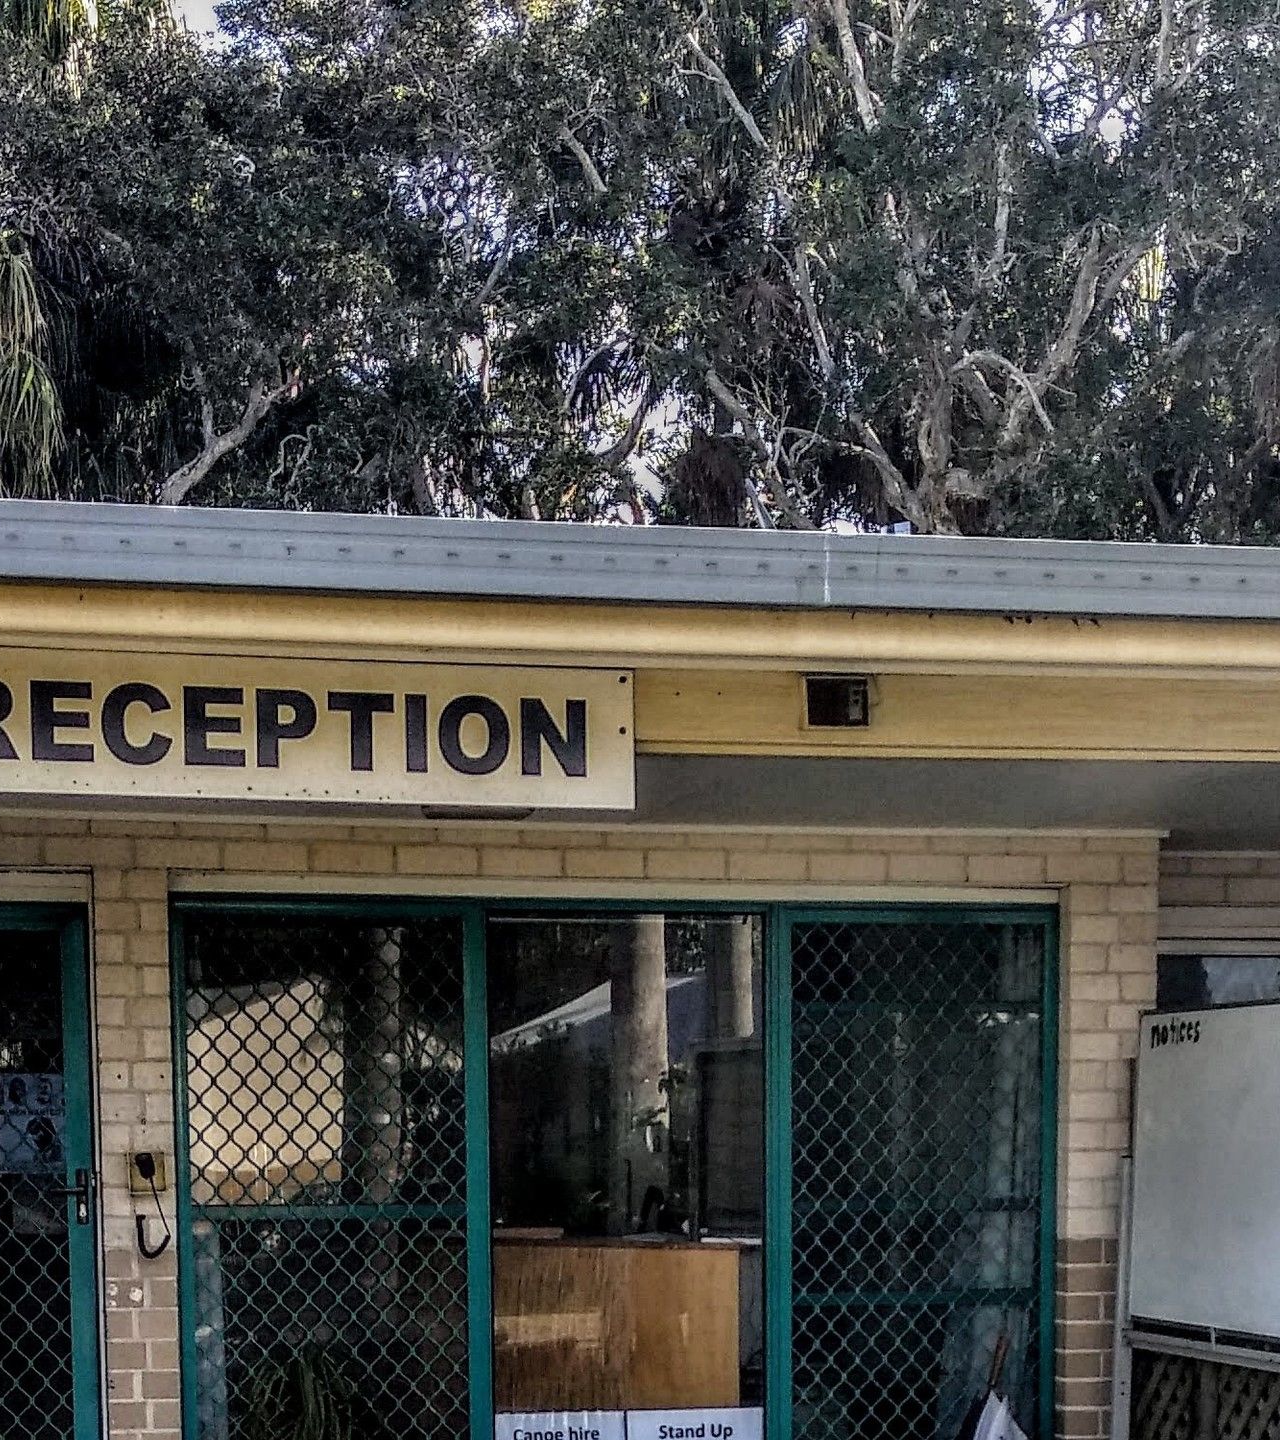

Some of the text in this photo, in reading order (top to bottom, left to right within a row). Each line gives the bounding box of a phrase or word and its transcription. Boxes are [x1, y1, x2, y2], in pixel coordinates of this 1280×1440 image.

[1150, 1016, 1201, 1049] notices
[658, 1424, 734, 1440] Stand Up
